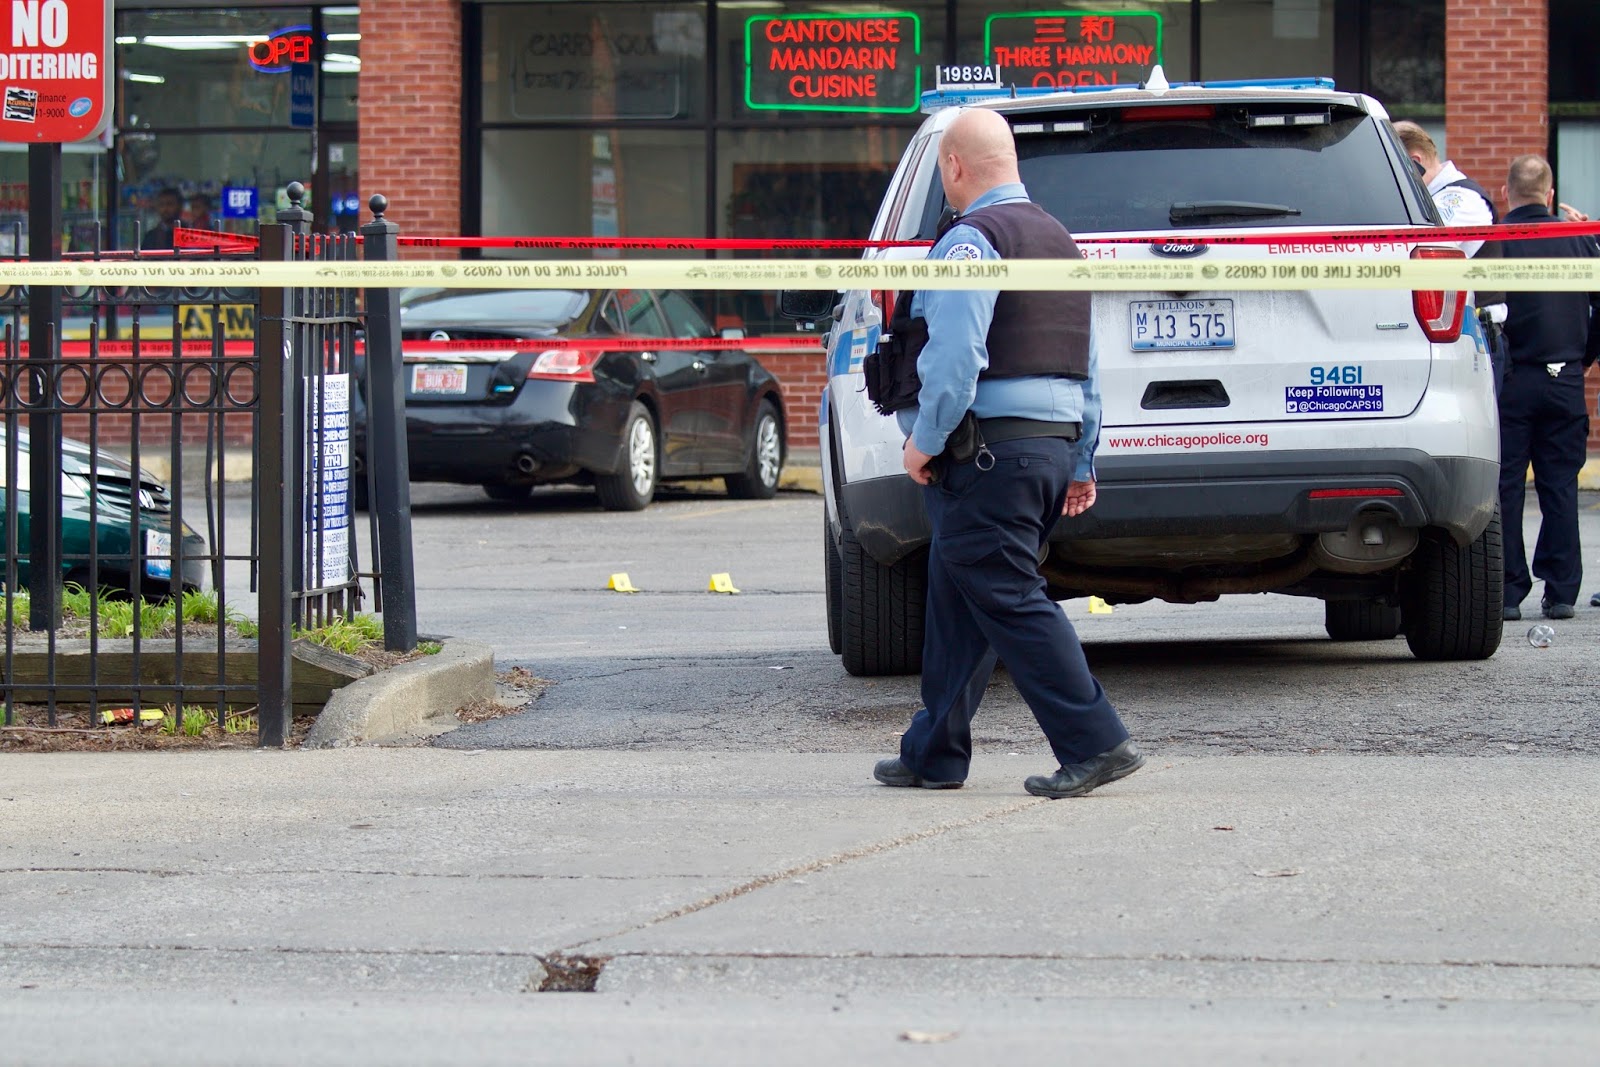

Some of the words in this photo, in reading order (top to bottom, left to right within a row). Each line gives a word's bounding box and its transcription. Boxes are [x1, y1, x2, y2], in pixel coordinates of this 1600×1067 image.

[12, 0, 68, 47] NO
[766, 20, 900, 42] CANTONESE
[769, 48, 896, 70] MANDARIN
[994, 47, 1051, 67] THREE
[1056, 44, 1154, 65] HARMONY
[0, 53, 97, 80] OITERING
[943, 67, 994, 82] 1983A
[789, 74, 877, 97] CUISINE
[1031, 70, 1117, 88] OPEN
[37, 94, 67, 102] dinance
[228, 190, 251, 208] EBT
[946, 246, 978, 261] CHICAGO
[1162, 243, 1196, 253] Ford
[1268, 243, 1364, 255] EMERGENCY
[1158, 301, 1205, 311] ILLINOIS
[1153, 315, 1177, 340] 13
[1189, 313, 1226, 339] 575
[1310, 366, 1362, 385] 9461
[1288, 388, 1313, 399] Keep
[1316, 387, 1365, 399] Following
[1368, 386, 1381, 397] Us
[1299, 400, 1382, 412] @ChicagoCAPS19
[1109, 433, 1268, 449] www.chicagopolice.org
